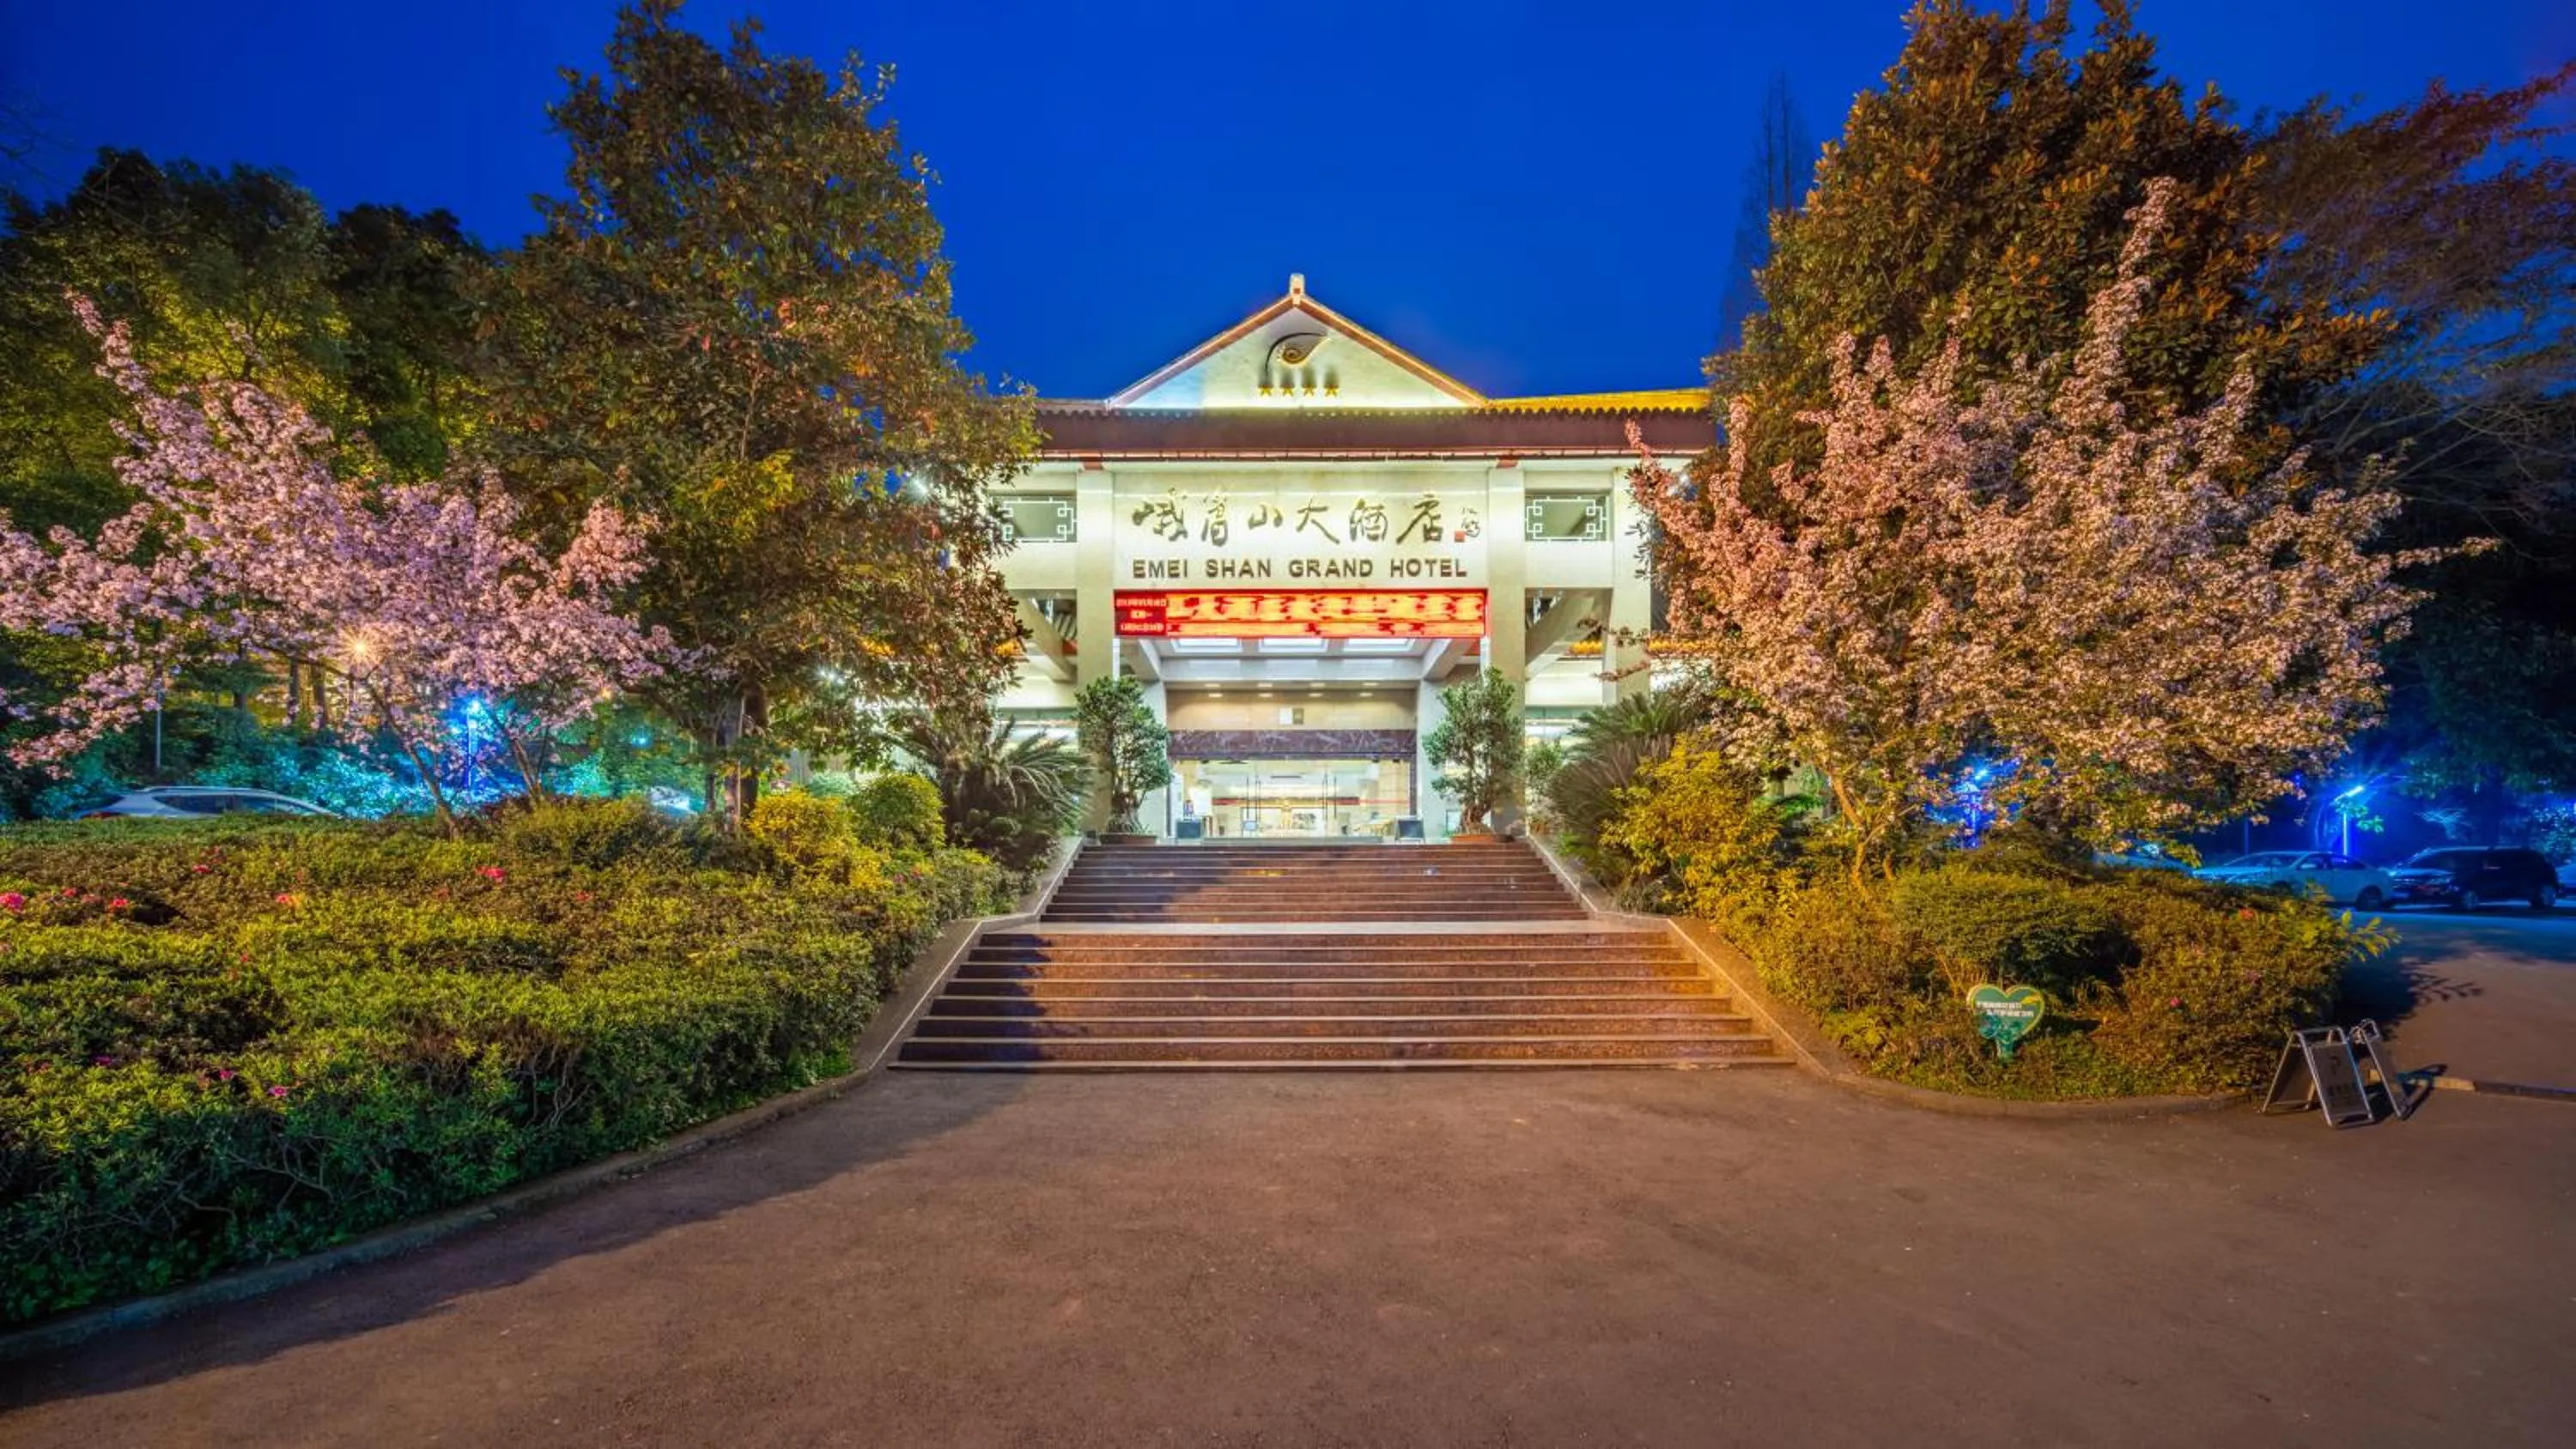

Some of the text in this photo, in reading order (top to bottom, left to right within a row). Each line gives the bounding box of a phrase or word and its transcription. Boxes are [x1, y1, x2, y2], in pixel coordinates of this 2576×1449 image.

[1133, 558, 1467, 579] EMEI SHAN GRAND HOTEL
